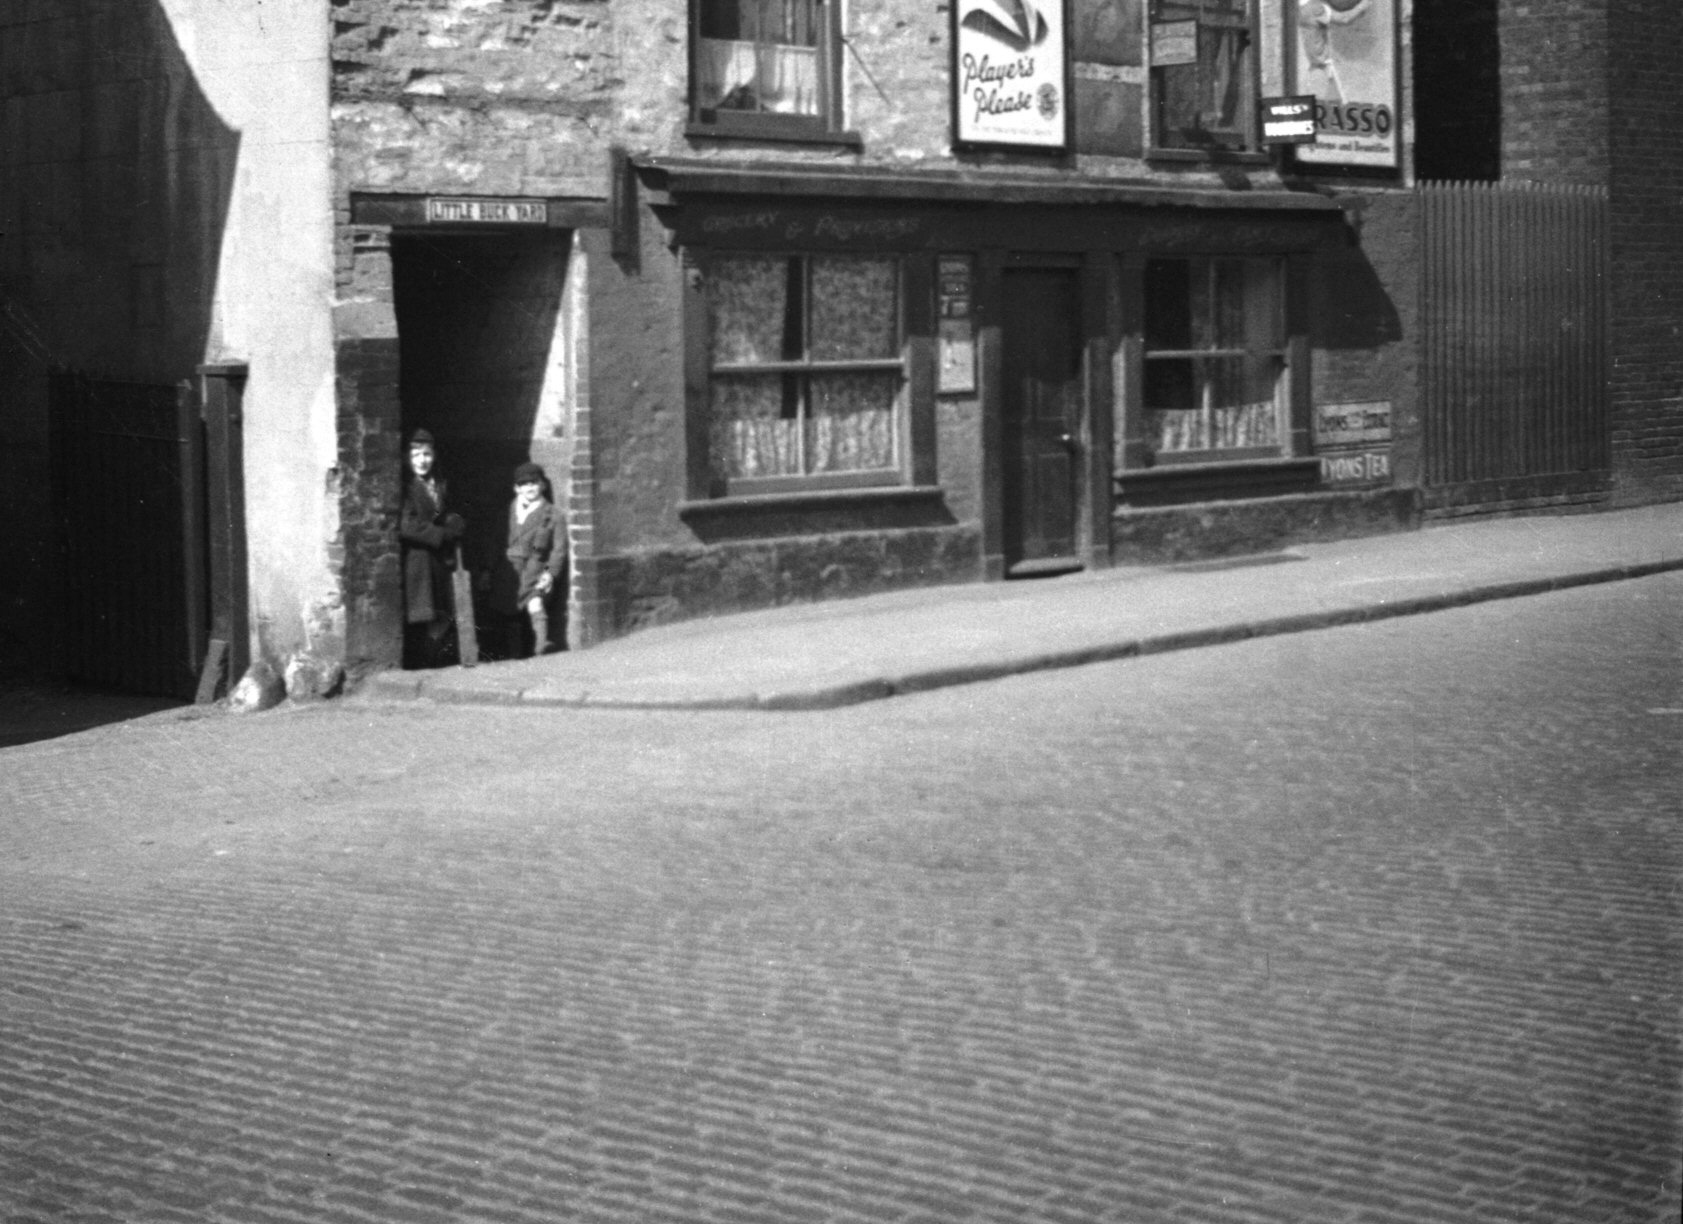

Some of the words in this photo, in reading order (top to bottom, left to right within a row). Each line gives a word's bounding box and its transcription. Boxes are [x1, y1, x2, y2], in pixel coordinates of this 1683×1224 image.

[963, 53, 1034, 94] Player's
[974, 87, 1032, 123] Please
[1315, 104, 1390, 134] RASSO
[433, 202, 473, 221] LITTLE
[480, 204, 510, 222] BUCK
[515, 204, 545, 222] YARD
[1365, 453, 1388, 480] TEA
